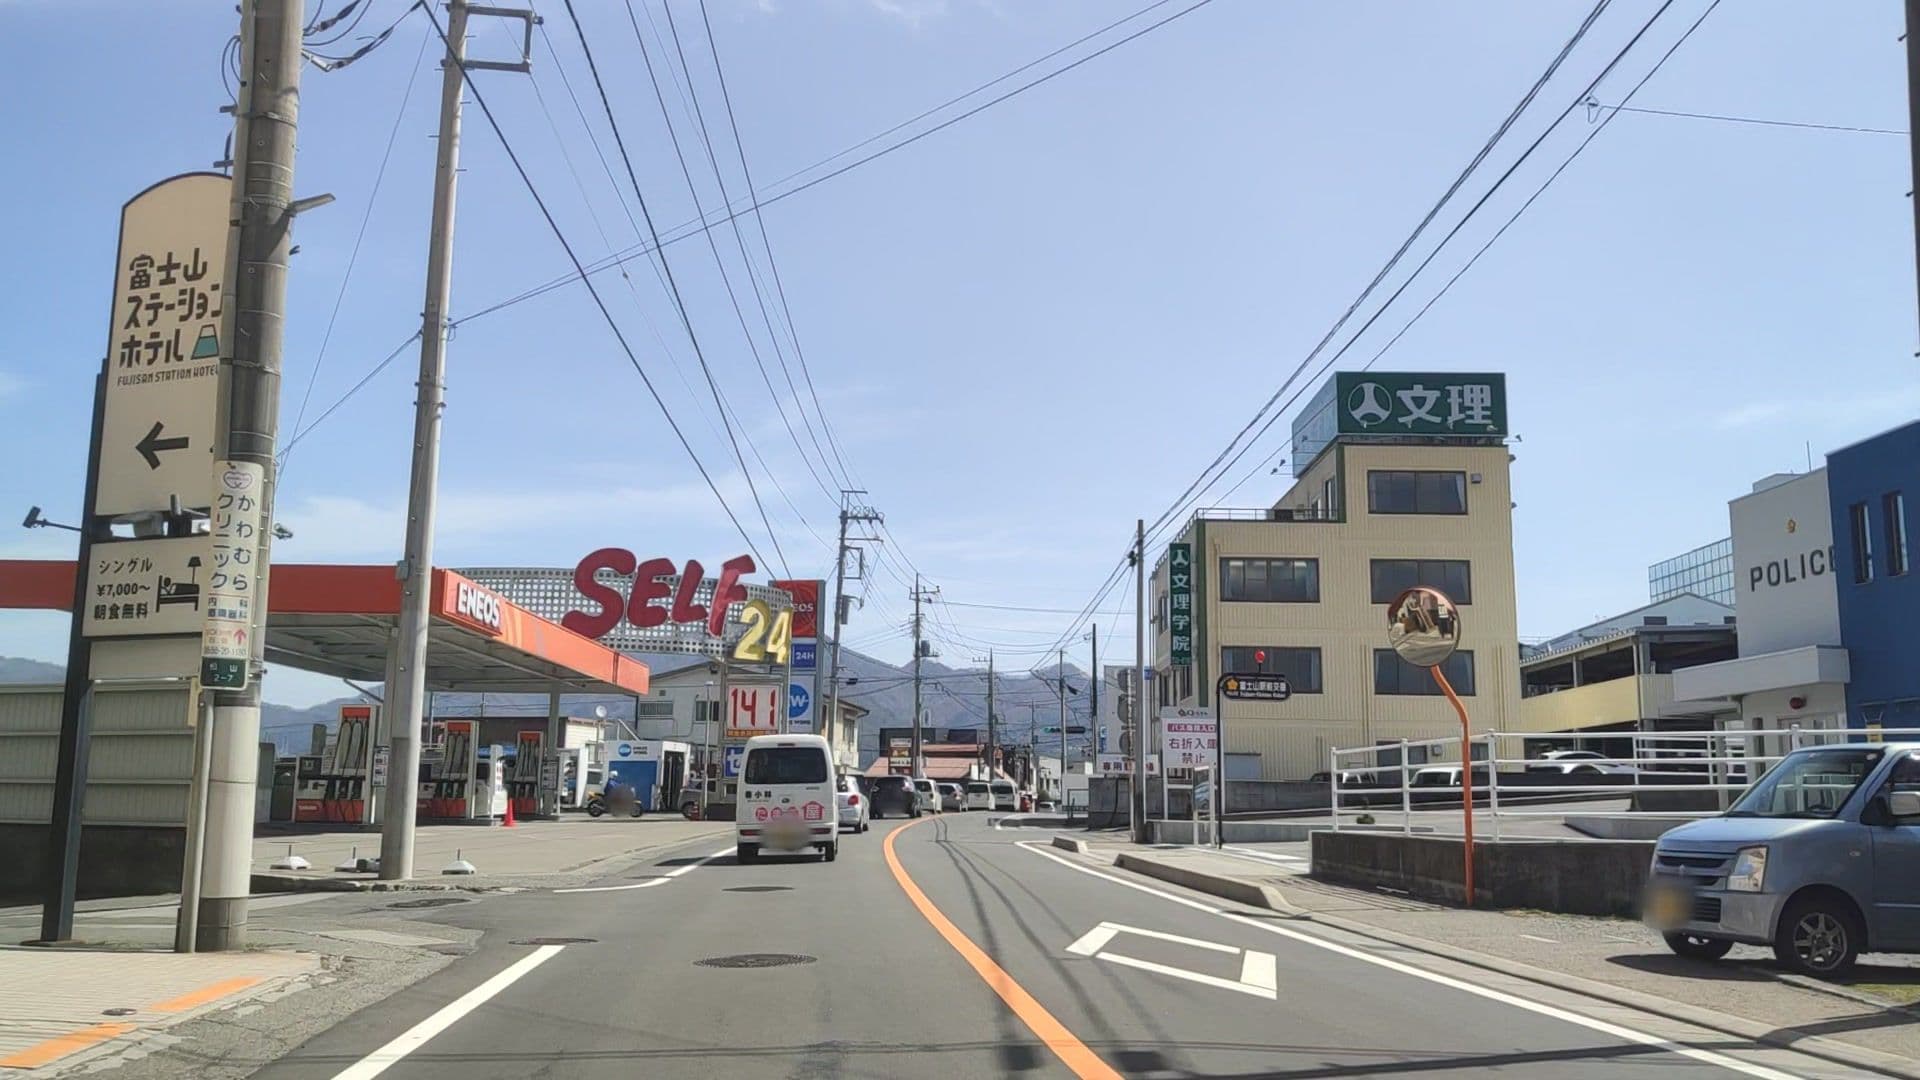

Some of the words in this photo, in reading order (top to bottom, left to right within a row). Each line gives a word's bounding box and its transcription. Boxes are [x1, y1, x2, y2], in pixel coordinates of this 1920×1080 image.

[129, 248, 208, 291] 富士山
[124, 283, 223, 330] ステーション
[119, 328, 184, 368] ホテル
[117, 369, 154, 386] FUJISAN
[155, 367, 192, 383] STATION
[1396, 384, 1493, 425] 文理
[210, 493, 235, 590] クリニック
[233, 494, 256, 592] かわむら
[99, 557, 153, 574] シングル
[94, 601, 149, 621] 朝食無料
[457, 582, 500, 628] ENEOS
[562, 548, 756, 639] SELF
[793, 603, 814, 612] EOS
[1171, 575, 1191, 652] 文理学院
[734, 599, 793, 664] 24
[795, 651, 815, 660] 24H
[731, 688, 776, 728] 141
[1168, 737, 1217, 750] 右折入庫
[1182, 752, 1206, 764] 禁止
